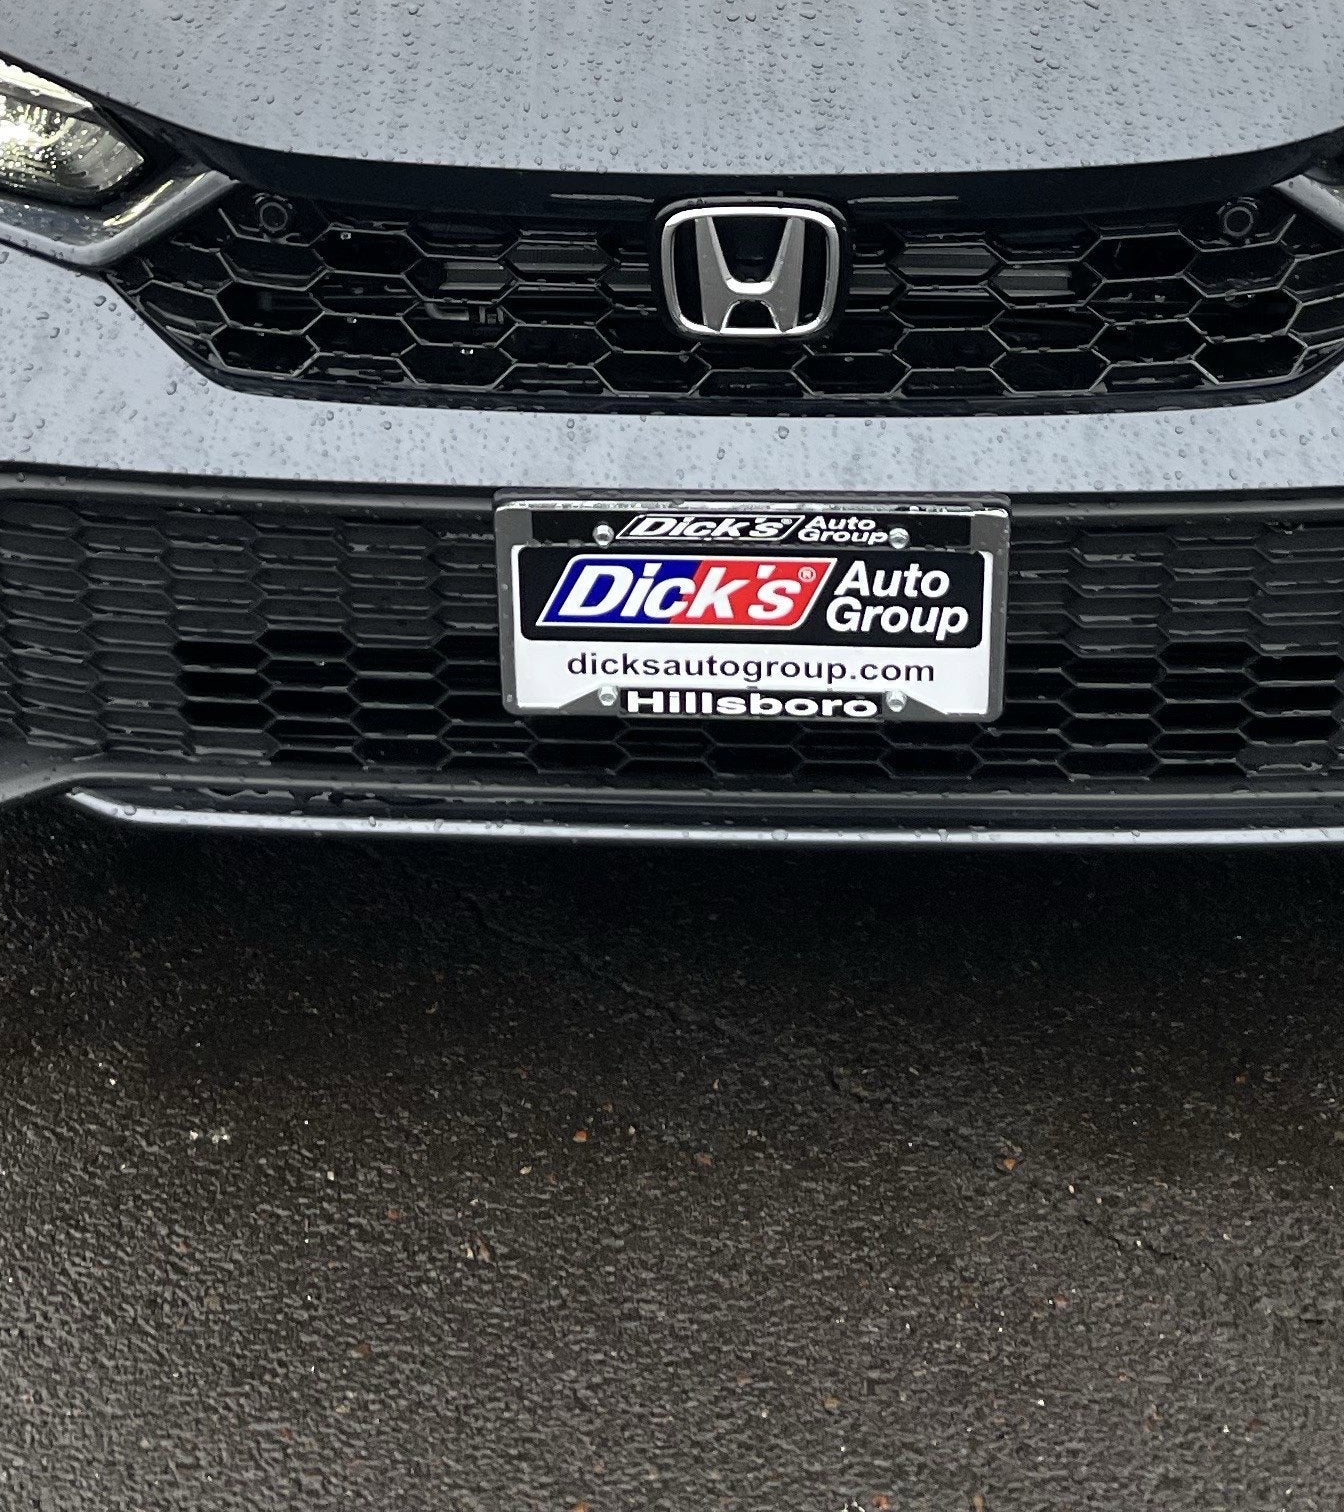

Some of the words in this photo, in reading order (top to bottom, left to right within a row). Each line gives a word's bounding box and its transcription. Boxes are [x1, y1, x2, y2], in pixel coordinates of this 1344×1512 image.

[629, 516, 785, 537] Dick's
[804, 515, 876, 530] Auto
[797, 528, 889, 546] Group
[557, 562, 803, 621] Dick's
[833, 559, 950, 598] Auto
[825, 595, 970, 642] Group
[566, 652, 936, 684] dicksautogroup.com
[625, 689, 879, 718] Hillsboro
